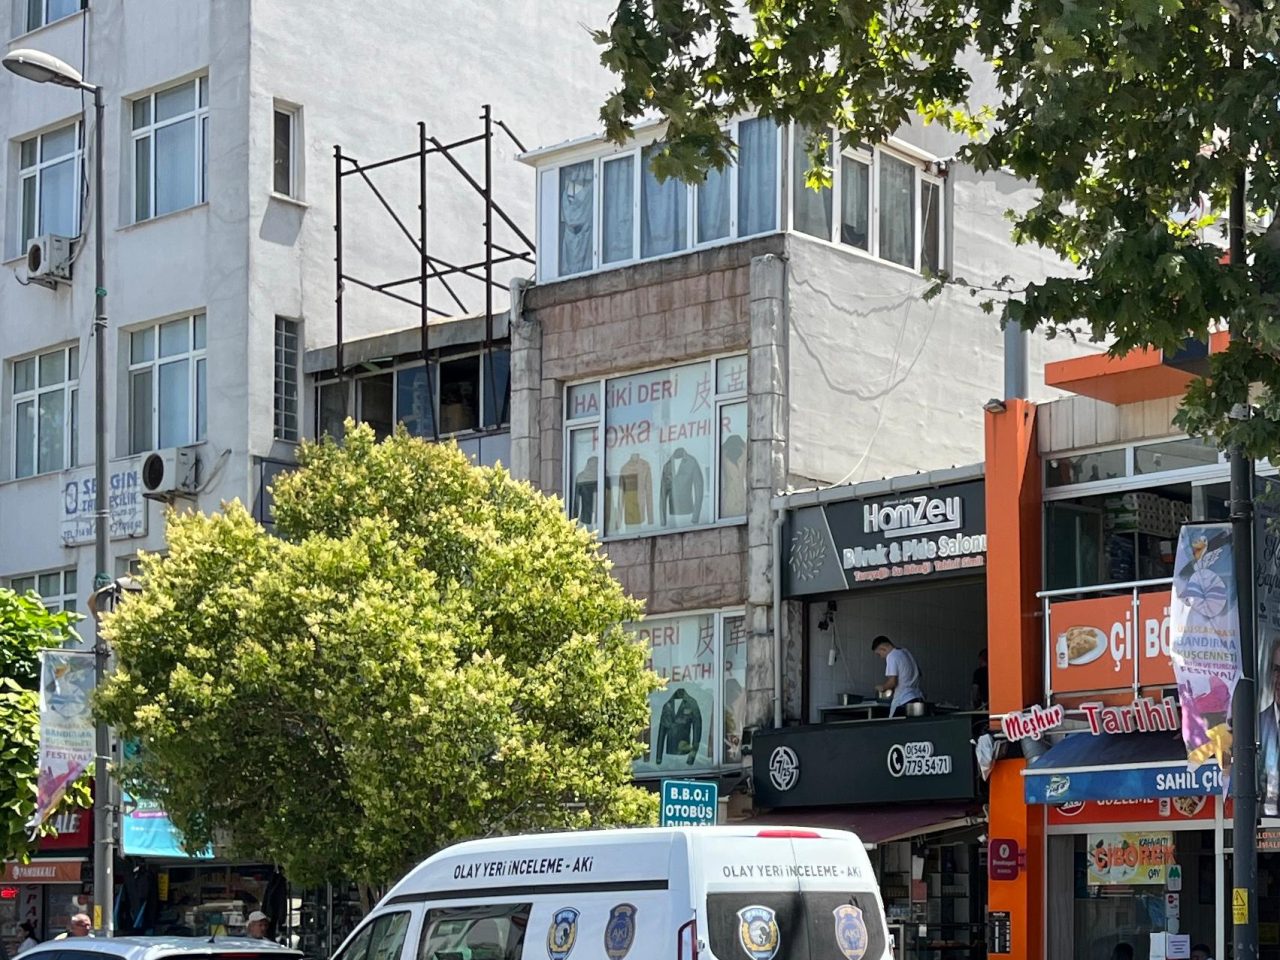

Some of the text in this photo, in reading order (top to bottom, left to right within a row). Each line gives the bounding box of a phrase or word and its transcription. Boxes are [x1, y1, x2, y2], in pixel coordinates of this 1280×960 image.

[638, 373, 678, 403] DERİ
[659, 416, 732, 444] LEATHR
[1110, 612, 1132, 672] Çİ
[661, 660, 734, 684] LEATHR
[1005, 707, 1062, 739] Meşhur
[1082, 698, 1177, 735] Tarihi
[907, 756, 949, 773] 779 54 71
[665, 803, 713, 819] OTOBÜS
[454, 863, 483, 880] OLAY
[722, 866, 754, 878] OLAY
